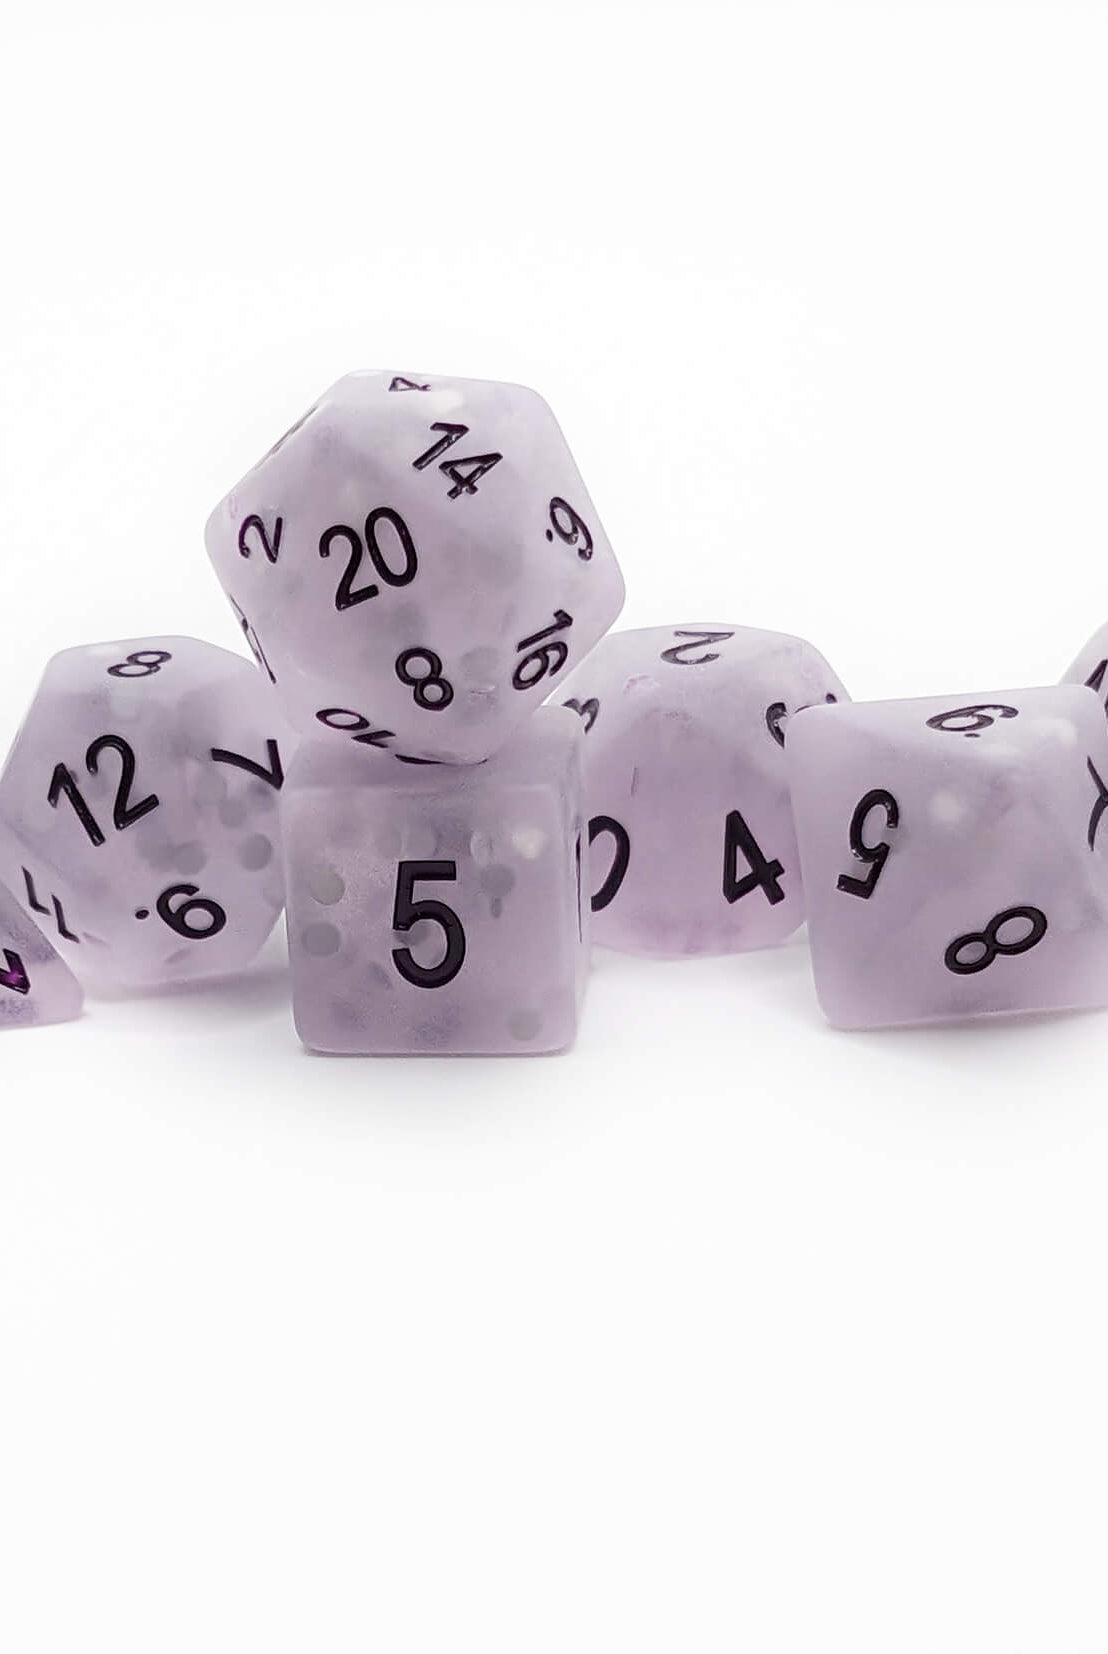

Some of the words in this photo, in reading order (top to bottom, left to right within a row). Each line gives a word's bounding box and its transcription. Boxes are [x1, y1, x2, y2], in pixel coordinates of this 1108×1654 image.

[412, 422, 503, 500] 14
[238, 513, 283, 564] 2
[318, 506, 418, 612] 20
[107, 640, 172, 678] 8
[394, 646, 455, 712] 8
[512, 609, 573, 691] 16
[661, 629, 735, 665] 2
[47, 734, 160, 847] 12
[722, 809, 786, 906] 4
[836, 788, 901, 900] 5
[391, 859, 467, 990] 5
[943, 905, 1048, 976] 8
